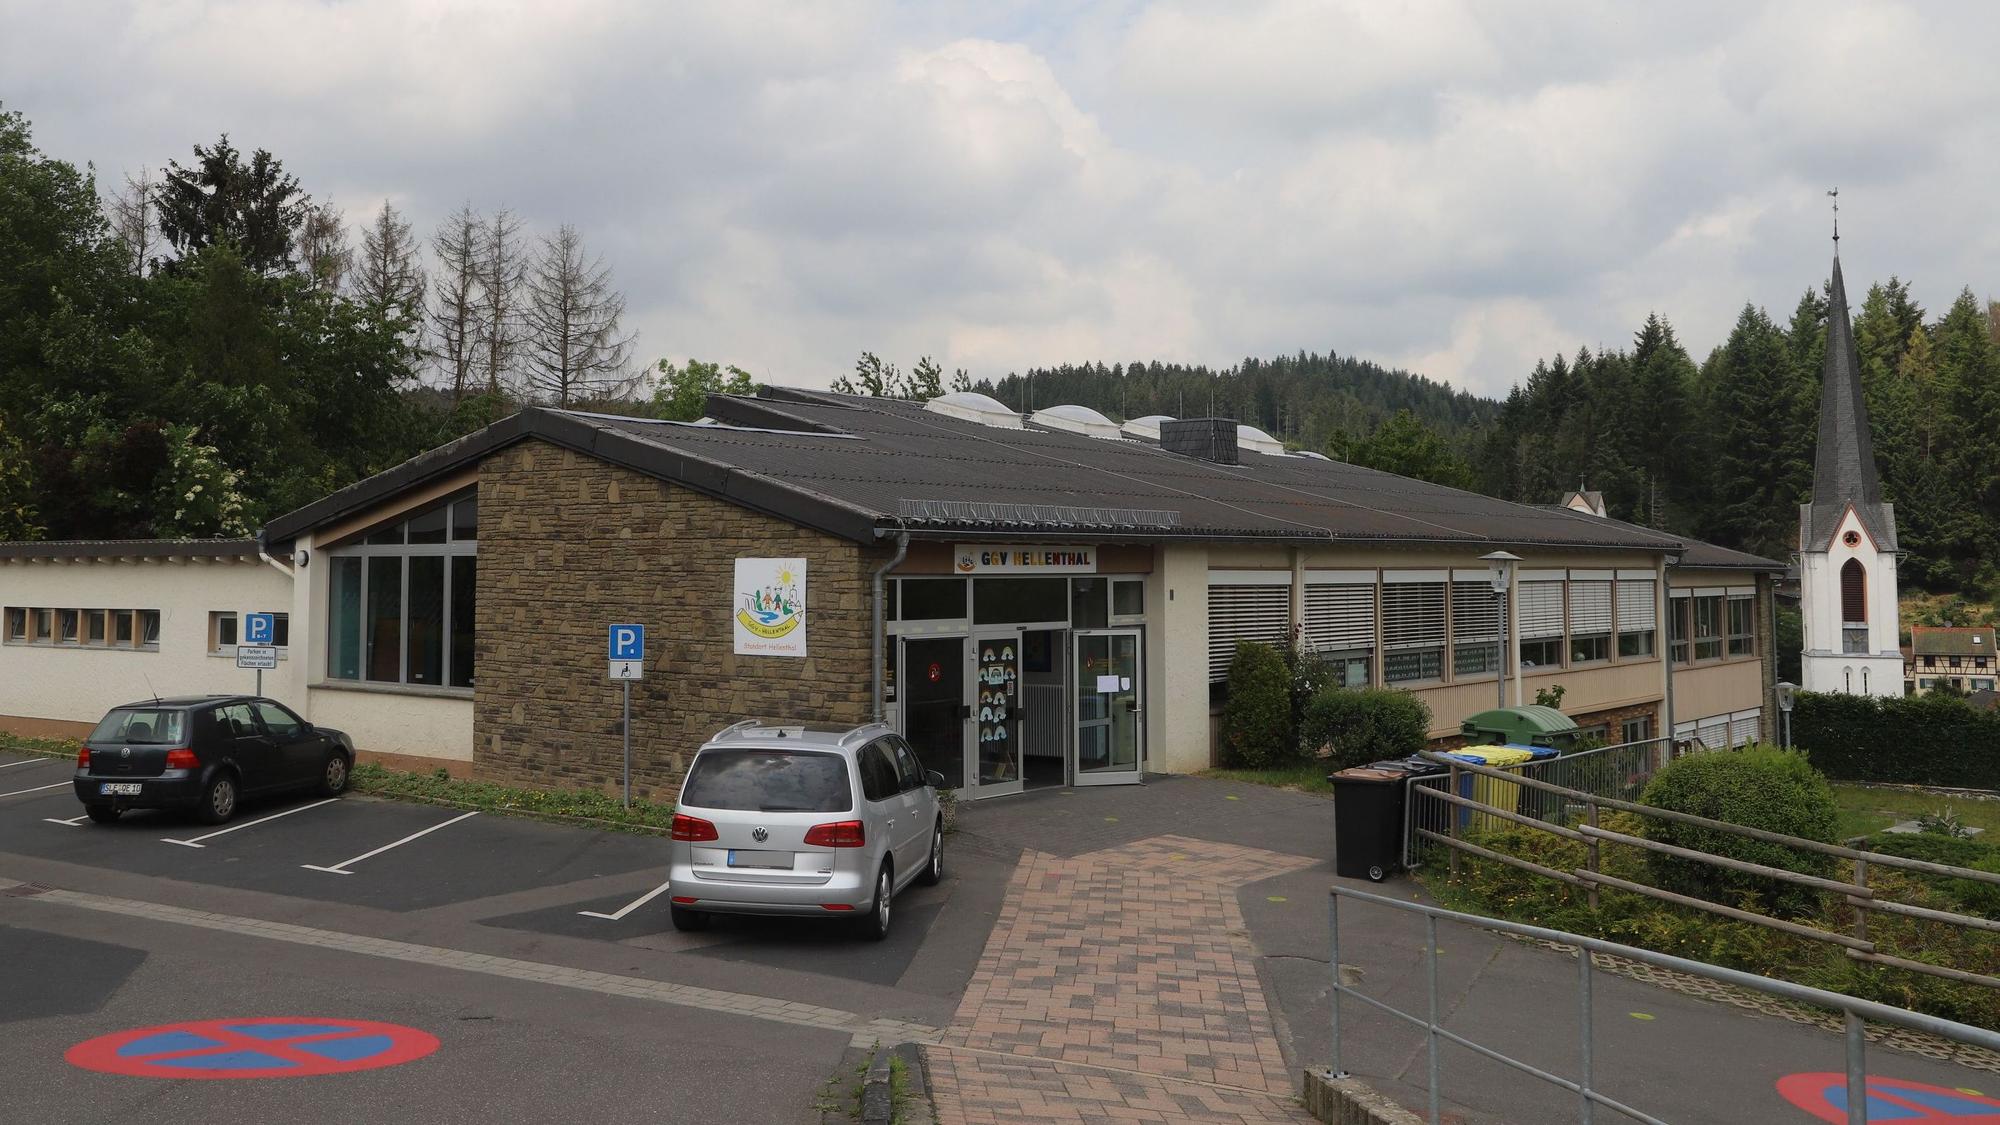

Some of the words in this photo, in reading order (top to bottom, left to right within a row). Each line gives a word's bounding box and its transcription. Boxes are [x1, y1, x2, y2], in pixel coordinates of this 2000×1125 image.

[981, 552, 1008, 566] GGV
[1013, 552, 1091, 566] HELLENTHAL
[251, 617, 267, 639] P
[617, 629, 636, 655] P
[769, 642, 798, 651] Hellenthal
